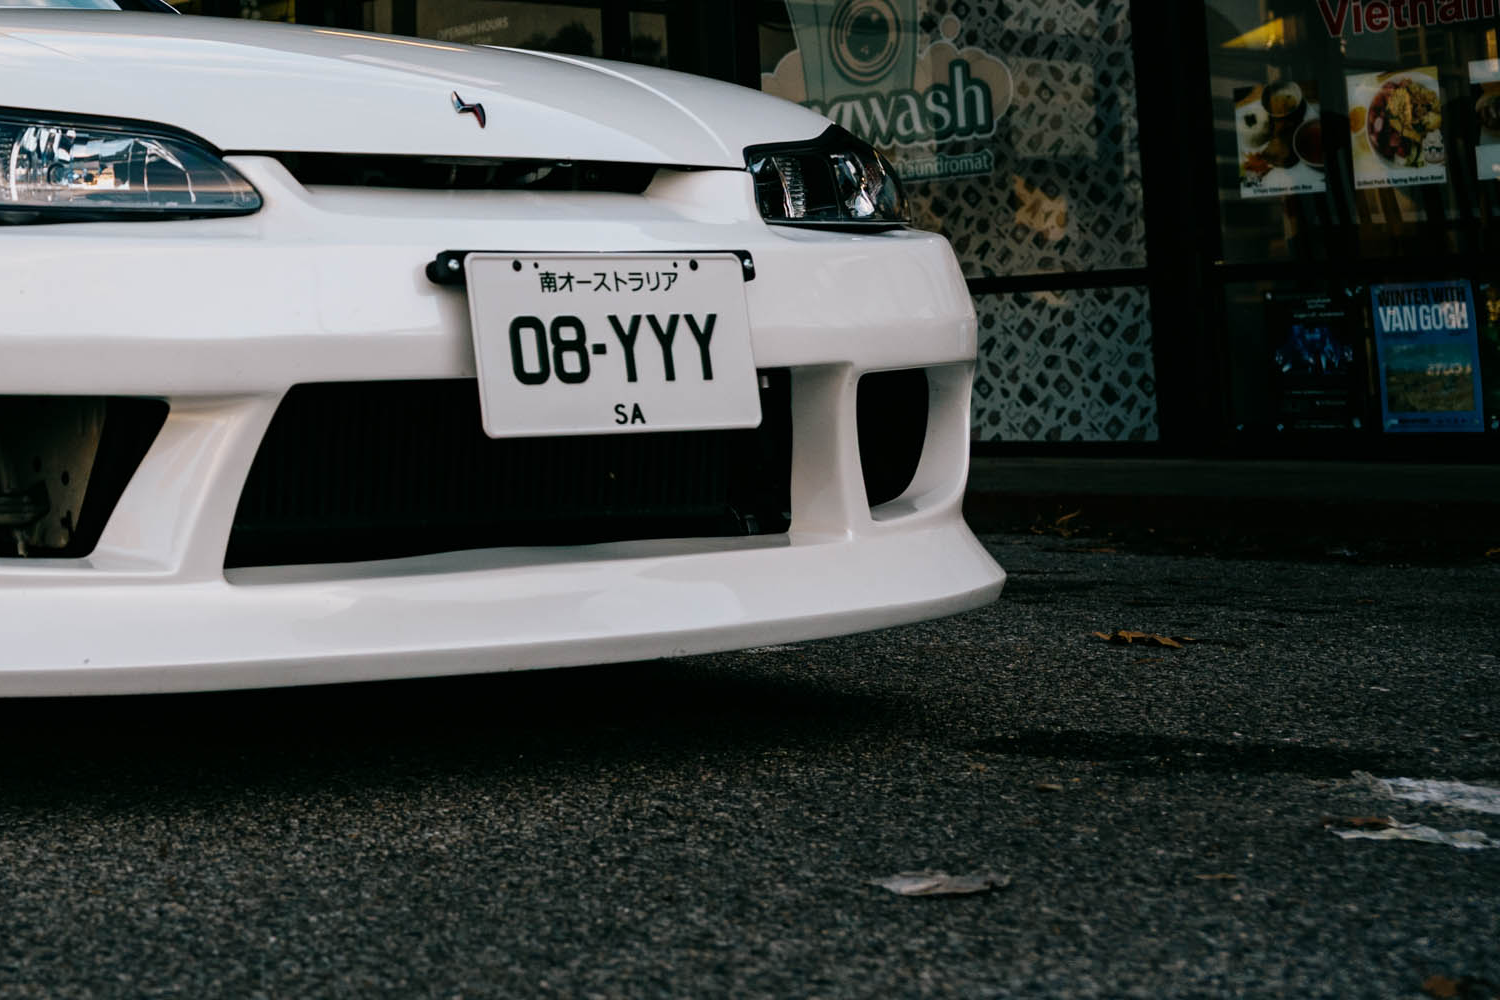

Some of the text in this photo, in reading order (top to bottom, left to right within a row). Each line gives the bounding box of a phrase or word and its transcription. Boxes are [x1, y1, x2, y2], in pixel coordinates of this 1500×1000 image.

[539, 271, 678, 293] 南オーストラリア
[1378, 301, 1469, 333] VAN GOGH
[508, 313, 718, 385] 08-YYY
[614, 403, 646, 425] SA
